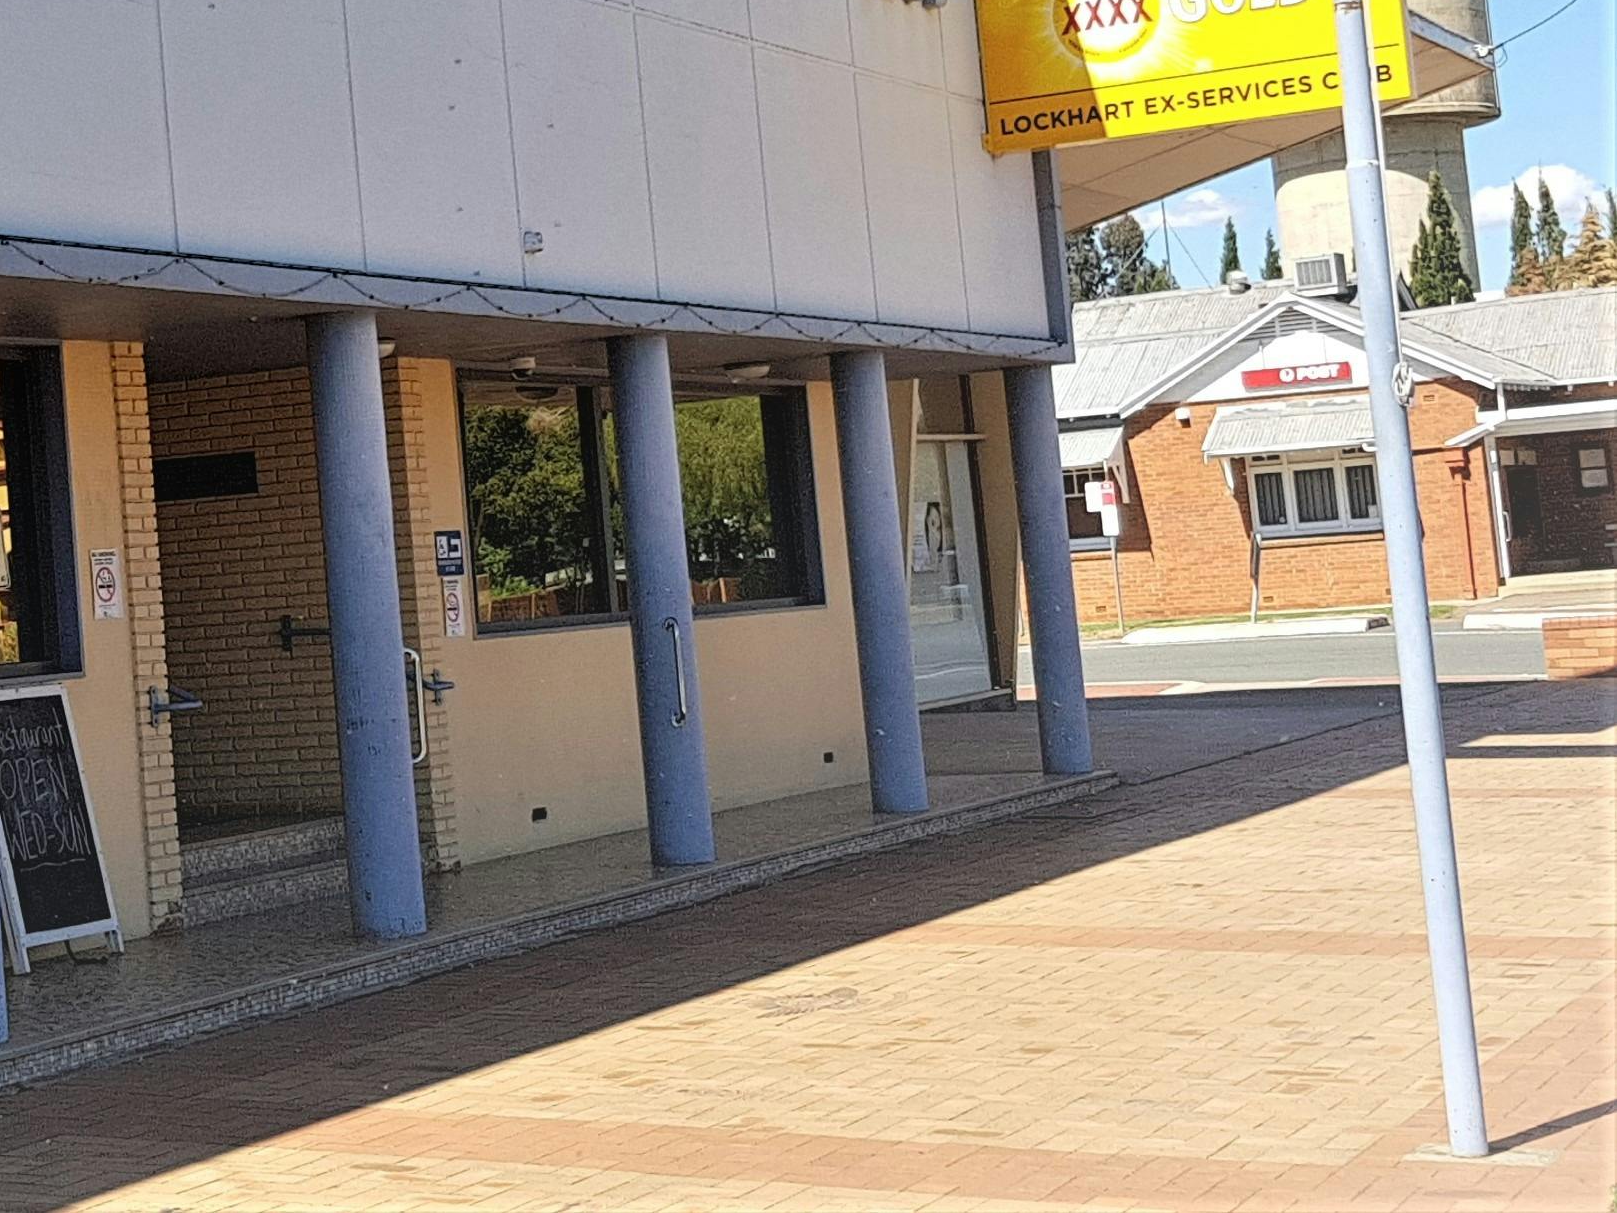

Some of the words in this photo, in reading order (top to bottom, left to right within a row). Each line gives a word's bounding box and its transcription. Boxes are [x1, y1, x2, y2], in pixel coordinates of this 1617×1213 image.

[1000, 100, 1135, 136] LOCKHART
[1144, 74, 1313, 116] EX-SERVICES
[1322, 64, 1393, 90] CB
[1296, 364, 1340, 381] POST
[1, 802, 92, 862] WED-SUN
